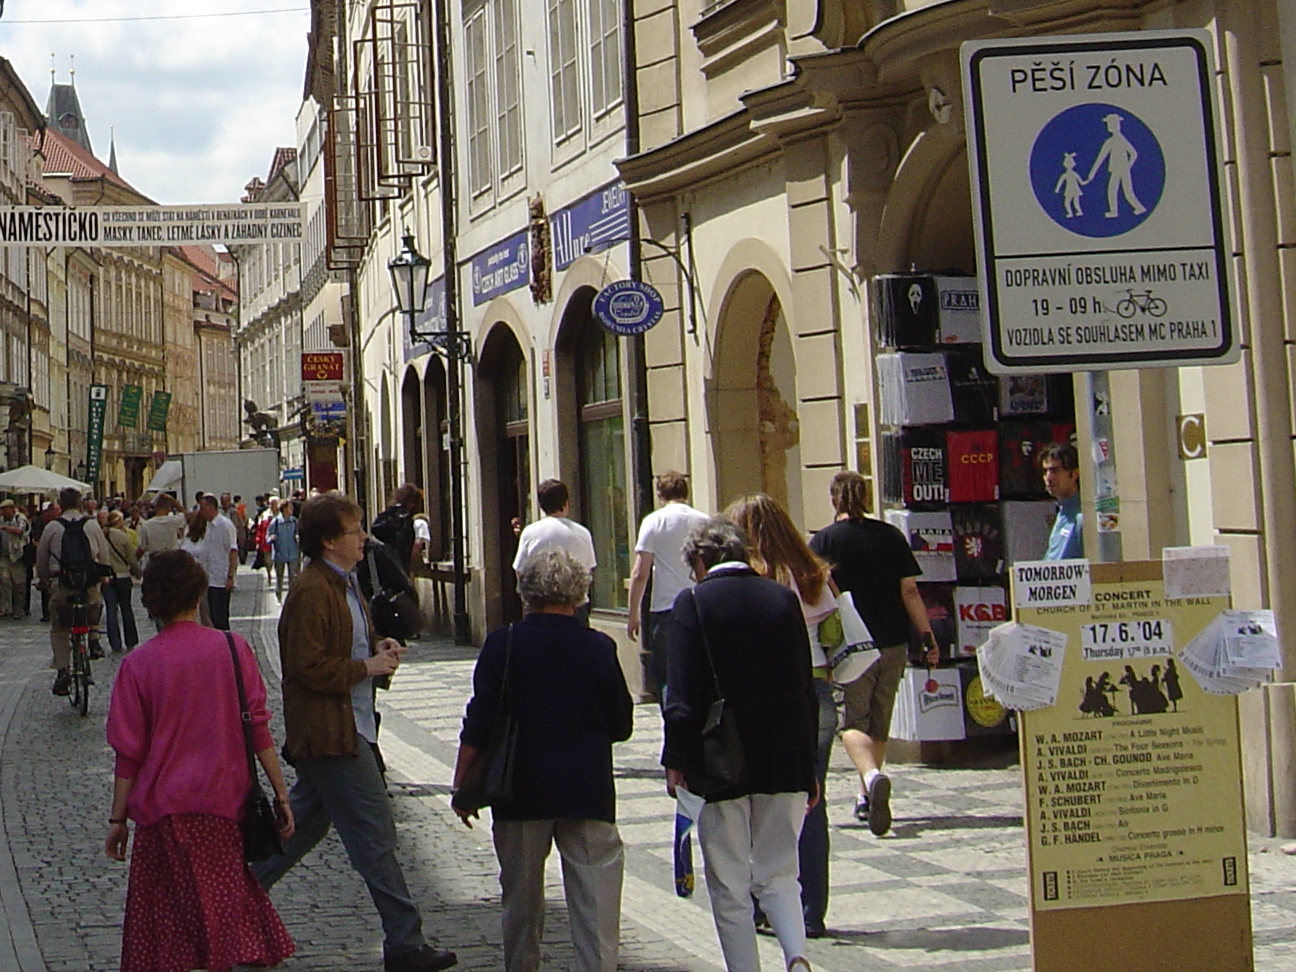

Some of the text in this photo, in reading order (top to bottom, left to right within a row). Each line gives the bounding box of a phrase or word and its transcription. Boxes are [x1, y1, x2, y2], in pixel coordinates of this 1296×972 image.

[1010, 58, 1168, 94] PĚŠÍ ZÓNA
[137, 225, 165, 242] TANEC,
[167, 222, 195, 241] LETMÉ
[196, 221, 222, 240] LÁSKY
[223, 224, 230, 240] A
[231, 220, 269, 239] ZÁHADNÝ
[271, 223, 302, 239] CIZINEC
[556, 210, 591, 268] Allure
[1005, 261, 1210, 288] DOPRAVNÍ OBSLUHA MIMO TAXI
[599, 281, 661, 303] FACTORY SHOP
[944, 292, 979, 308] PRAH
[1032, 298, 1051, 317] 19
[1069, 296, 1089, 315] 09
[1093, 295, 1102, 314] h
[598, 311, 661, 334] BOHEMIA CRYSTAL
[1006, 326, 1056, 348] VOZIDLA
[1058, 325, 1073, 346] SE
[1075, 322, 1145, 346] SOUHLASEM
[1169, 320, 1207, 340] PRAHA
[1210, 319, 1217, 338] 1
[303, 361, 340, 371] GRANÁT
[911, 447, 943, 460] CZECH
[911, 460, 944, 484] ME
[913, 484, 944, 502] OUT!
[1018, 564, 1085, 584] TOMORROW
[1028, 584, 1078, 603] MORGEN
[1095, 590, 1152, 603] CONCERT
[959, 603, 1007, 622] KGB
[1036, 603, 1079, 616] CHURCH
[1080, 603, 1092, 613] OF
[1111, 600, 1148, 612] MARTIN
[1150, 599, 1163, 609] IN
[1164, 598, 1184, 608] THE
[1186, 596, 1212, 607] WALL
[1084, 645, 1124, 659] Thursday
[1035, 734, 1049, 746] W.
[1051, 733, 1062, 744] A.
[1063, 731, 1103, 744] MOZART
[1130, 730, 1136, 739] A
[1137, 728, 1158, 738] Little
[1159, 726, 1180, 738] Night
[1181, 725, 1204, 736] Music
[1036, 747, 1047, 758] A.
[1048, 743, 1088, 757] VIVALDI
[1114, 742, 1129, 752] The
[1131, 741, 1148, 751] Four
[1151, 739, 1184, 750] Seasons
[1036, 750, 1193, 771] J. S. BACH CH. GOUNOD Ave Maria
[1037, 771, 1048, 783] A.
[1050, 769, 1089, 782] VIVALDI
[1115, 766, 1151, 778] Concerto
[1038, 784, 1052, 796] W.
[1053, 784, 1065, 795] A.
[1067, 780, 1106, 794] MOZART
[1132, 776, 1180, 789] Divertimento
[1039, 790, 1166, 808] F. SCHUBERT Ave Maria
[1040, 810, 1051, 821] A.
[1052, 807, 1091, 820] VIVALDI
[1118, 805, 1150, 816] Sinfonia
[1040, 818, 1129, 834] J. S. BACH Air
[1041, 835, 1051, 846] G.
[1053, 834, 1063, 845] F.
[1128, 830, 1161, 841] Concerto
[1109, 850, 1173, 864] MUSICA PRAGA
